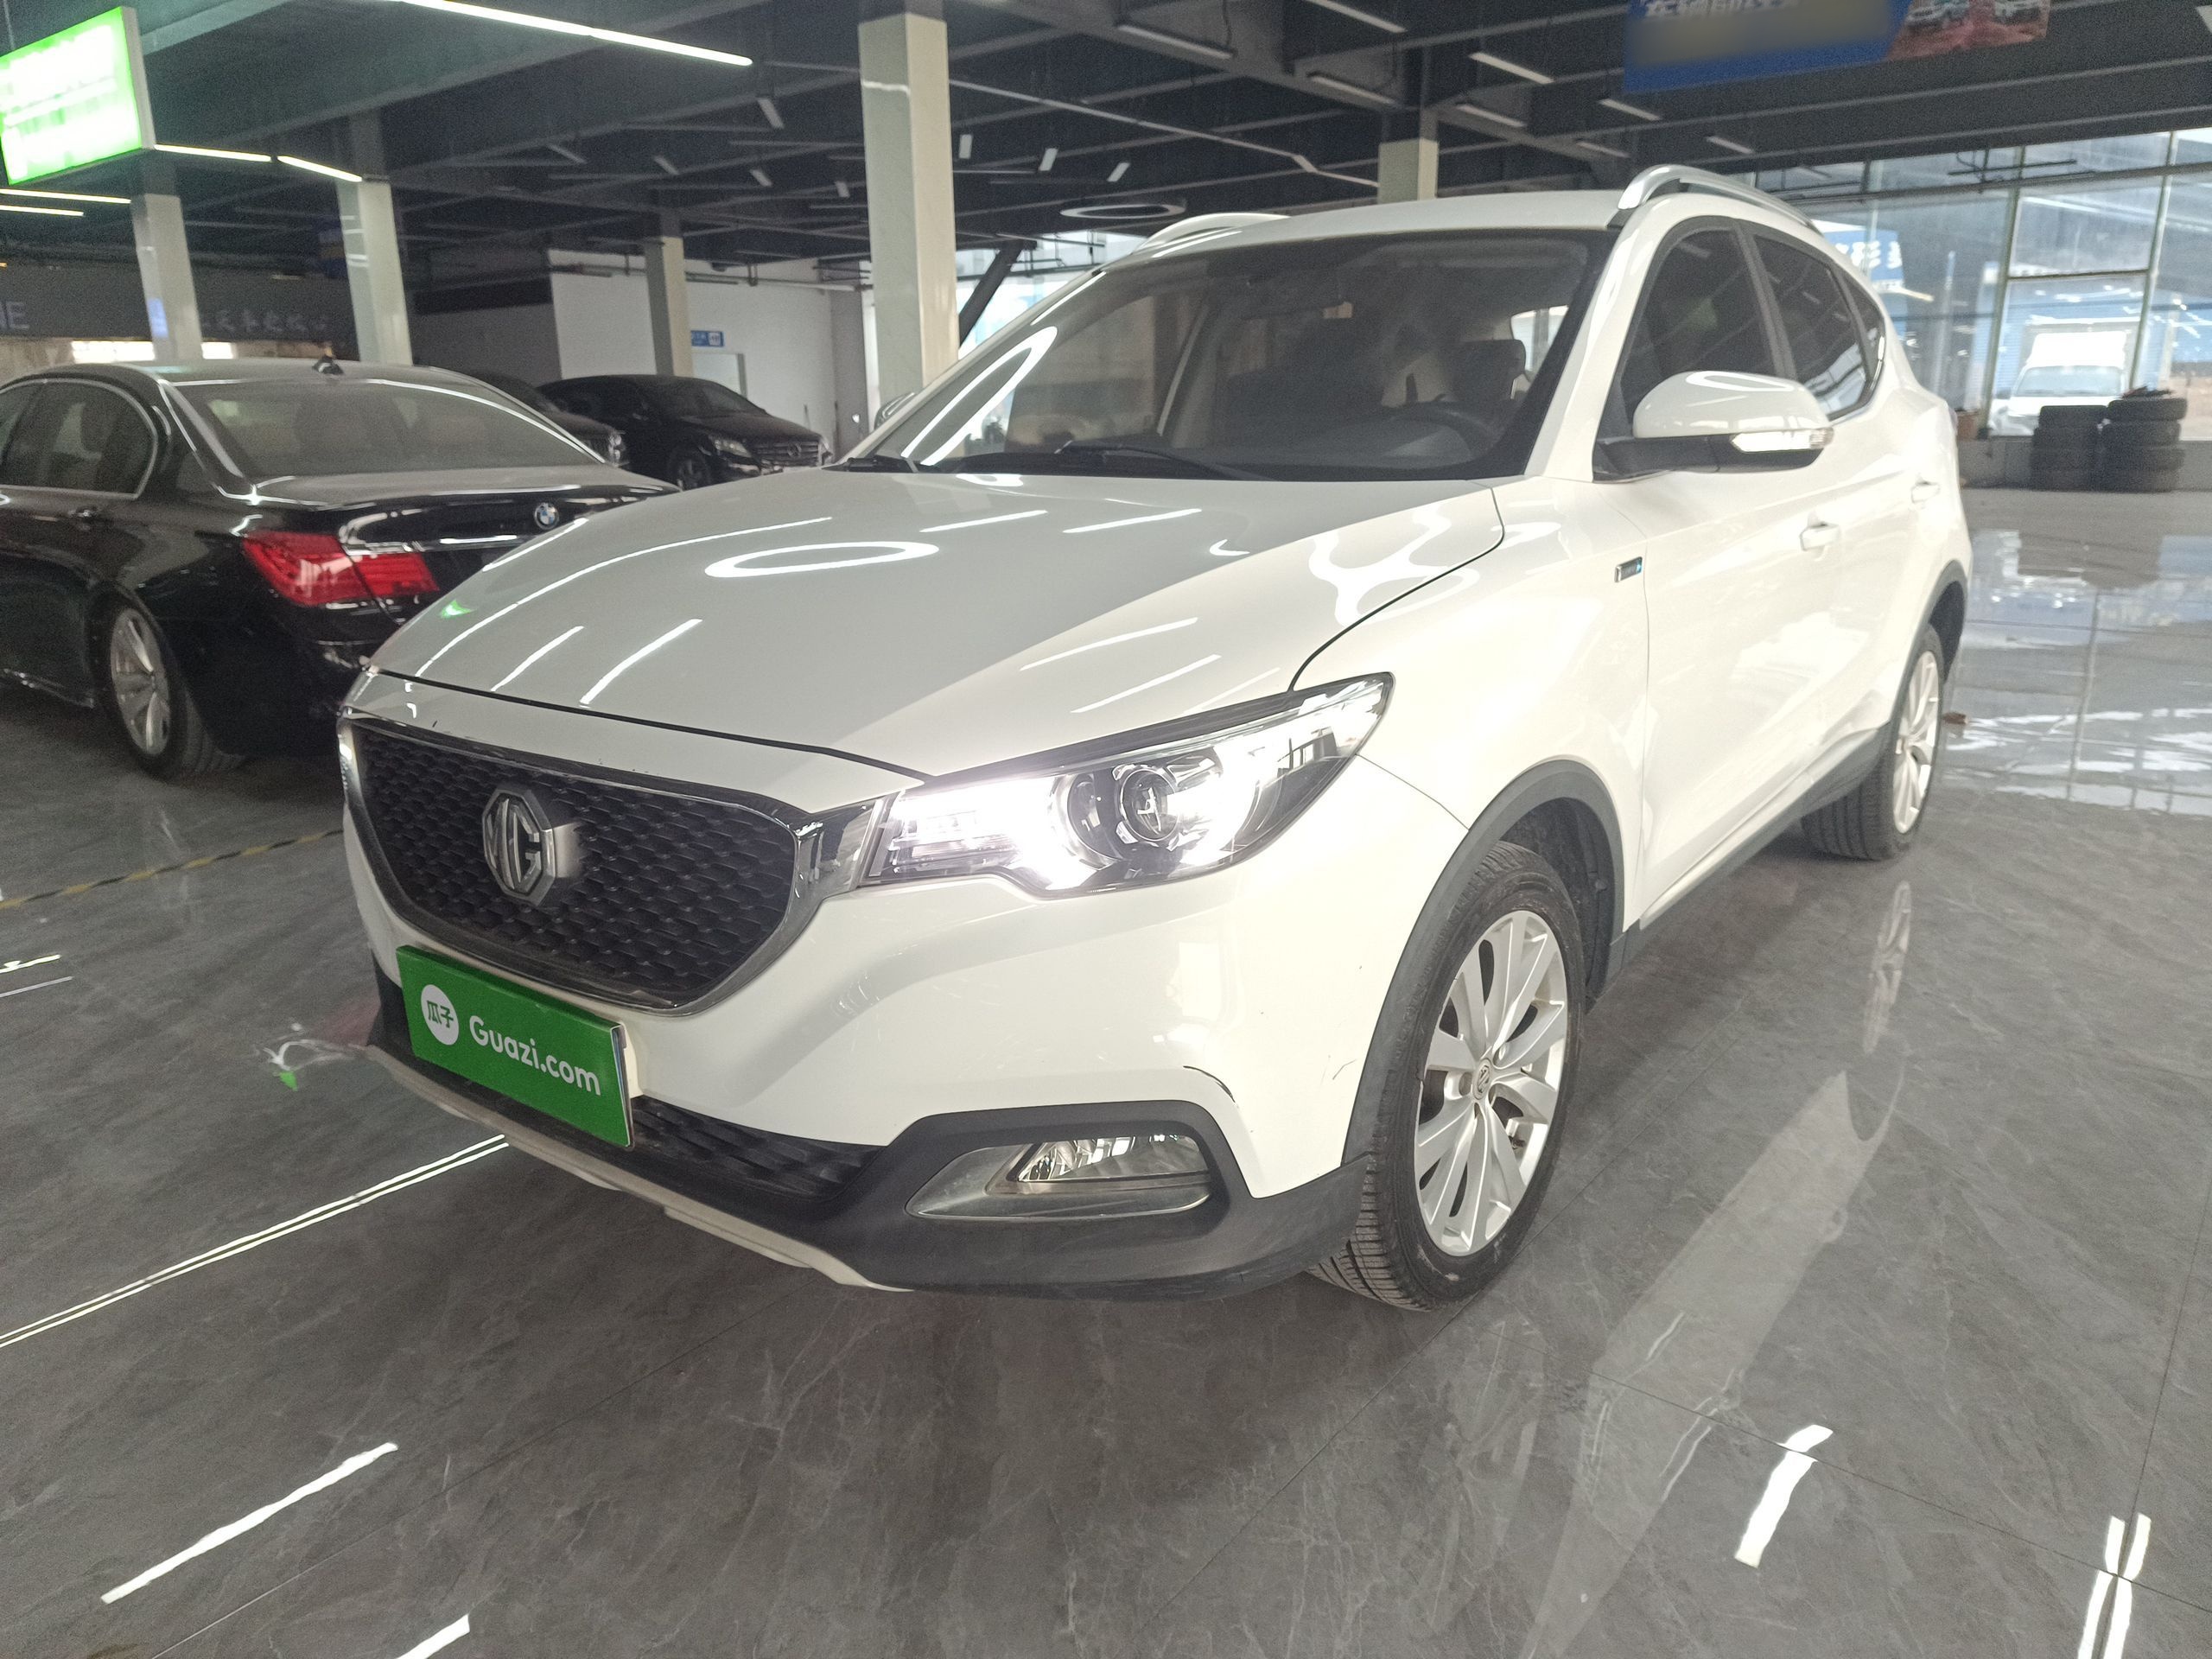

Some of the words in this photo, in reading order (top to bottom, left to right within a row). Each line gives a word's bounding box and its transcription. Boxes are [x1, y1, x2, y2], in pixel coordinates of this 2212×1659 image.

[486, 797, 543, 893] MG
[426, 1000, 454, 1029] 瓜子
[468, 1014, 601, 1096] Guazi.com
